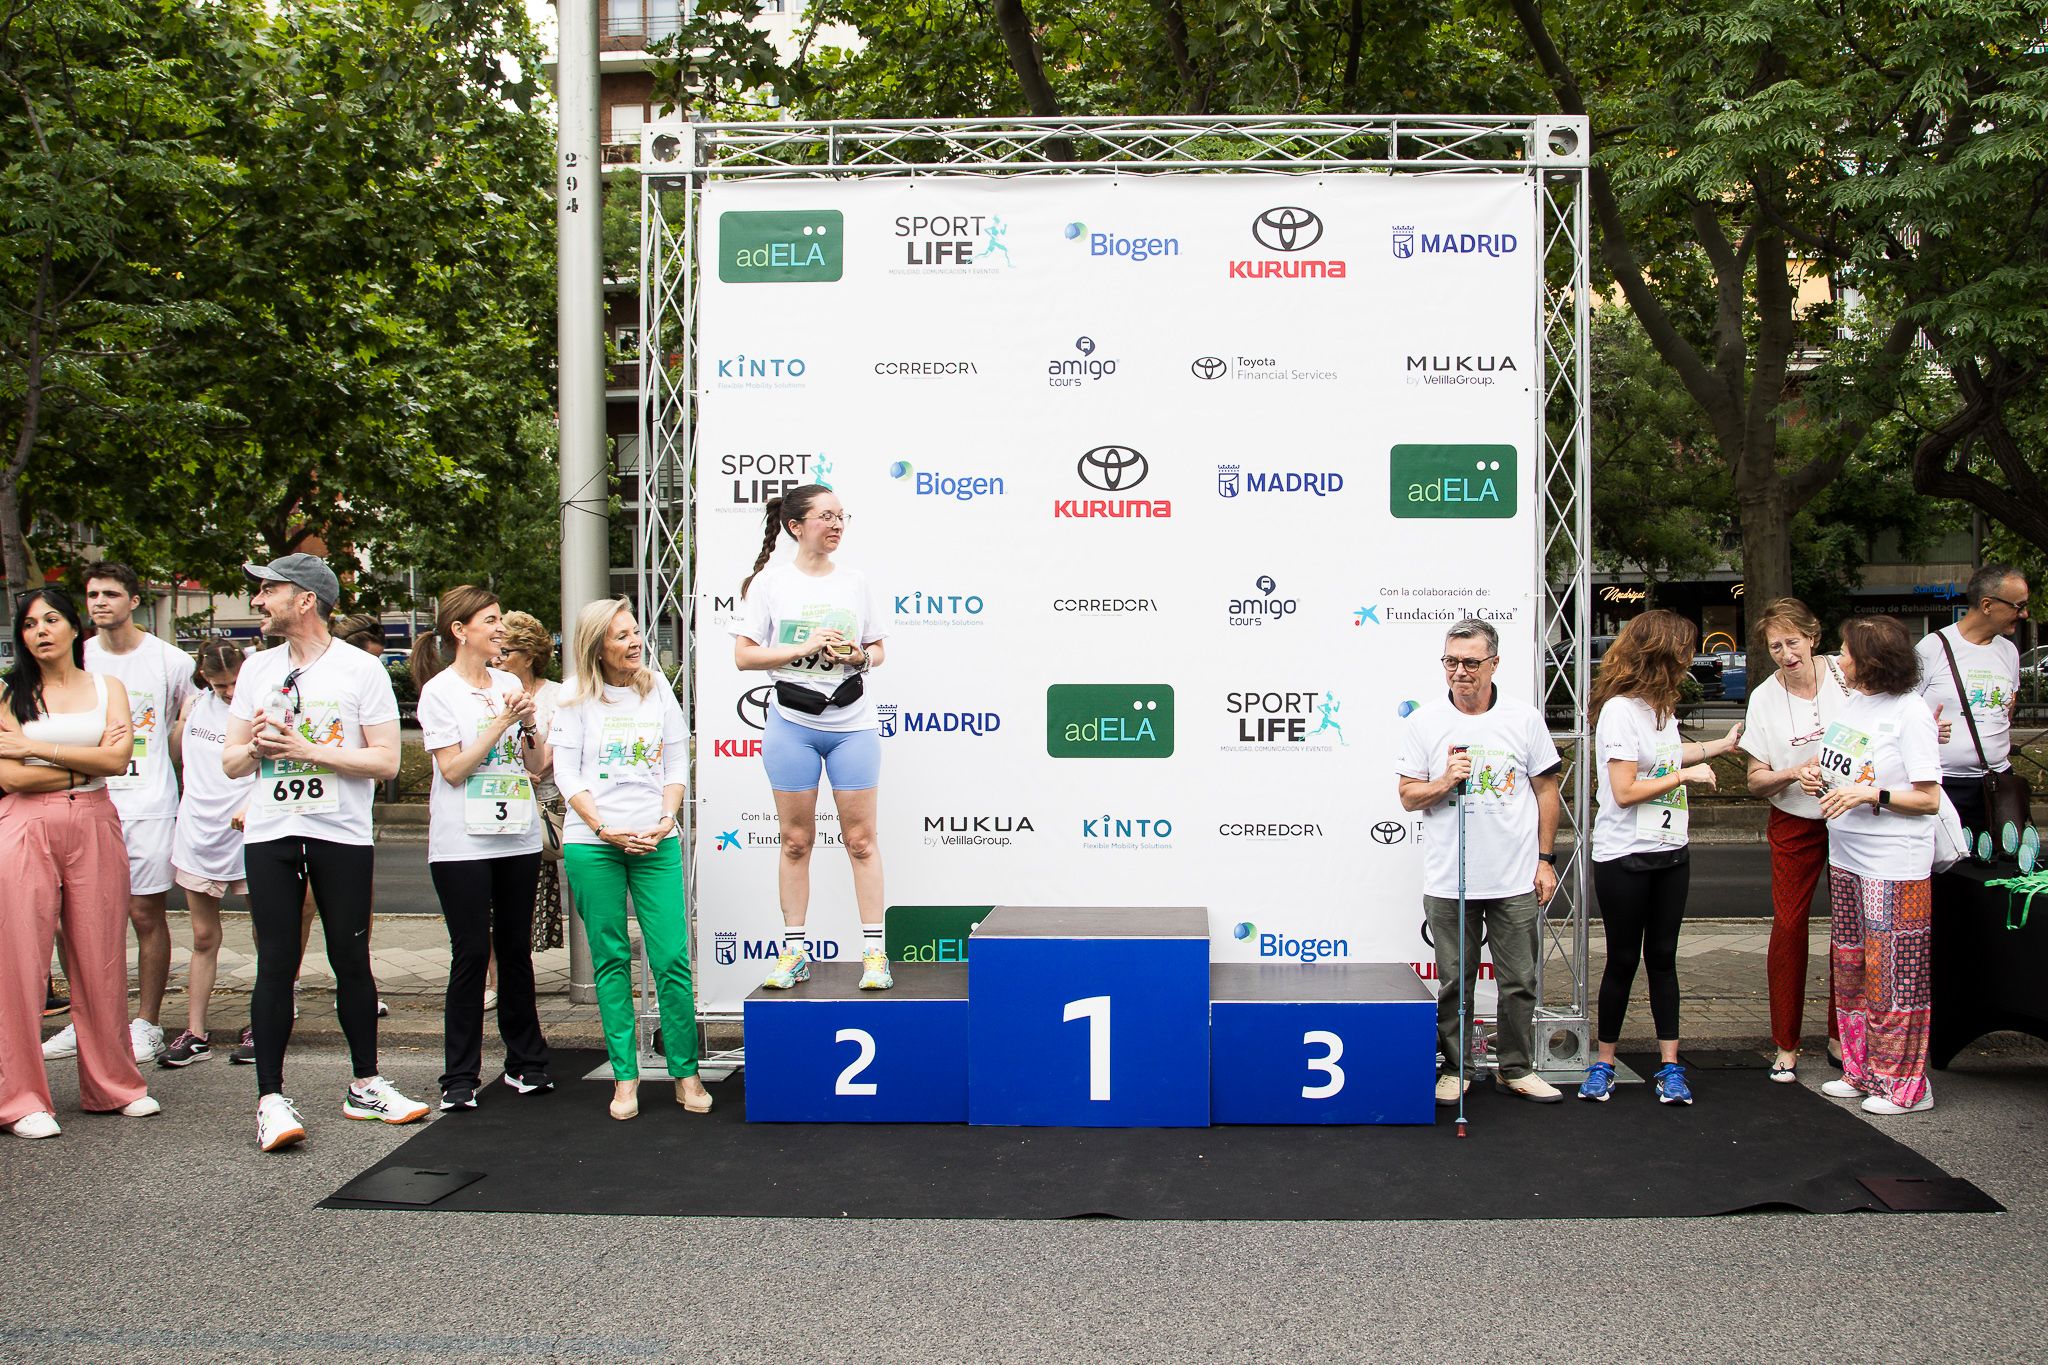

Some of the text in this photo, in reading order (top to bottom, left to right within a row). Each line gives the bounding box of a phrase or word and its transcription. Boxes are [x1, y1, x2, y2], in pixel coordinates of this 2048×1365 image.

[895, 216, 986, 237] SPORT
[736, 242, 826, 268] adELA
[907, 241, 973, 265] LIFE
[1090, 233, 1179, 262] Biogen
[1421, 233, 1518, 258] MADRID
[1048, 359, 1116, 381] amigo
[1237, 356, 1276, 369] Toyota
[1407, 356, 1517, 371] MUKUA
[1049, 376, 1082, 387] tours
[1237, 369, 1338, 380] Financial Services
[1406, 375, 1420, 387] by
[721, 454, 812, 475] SPORT
[916, 472, 1004, 501] Biogen
[1247, 472, 1344, 497] MADRID
[1407, 478, 1500, 502] adELA
[1379, 587, 1491, 597] Con la colaboración de:
[1913, 583, 1946, 594] Sanitas
[1228, 599, 1296, 620] amigo
[1386, 607, 1455, 621] Fundación
[1853, 602, 1953, 613] Centro de Rehabilitac
[923, 619, 949, 628] Mobility
[1229, 616, 1262, 627] tours
[1226, 692, 1319, 714] SPORT
[904, 712, 1001, 737] MADRID
[1064, 717, 1157, 742] adELA
[1239, 718, 1306, 742] LIFE
[714, 739, 762, 757] KUR
[1820, 747, 1852, 776] 1198
[273, 778, 324, 802] 698
[495, 801, 508, 821] 3
[741, 812, 760, 821] Con
[763, 812, 771, 821] la
[1661, 810, 1672, 829] 2
[924, 816, 1035, 832] MUKUA
[924, 835, 1012, 848] by VelillaGroup.
[1111, 842, 1139, 851] Mobility
[743, 940, 839, 963] MARID
[903, 938, 968, 962] adEL
[1259, 933, 1348, 962] Biogen
[1062, 994, 1111, 1102] 1
[834, 1028, 878, 1096] 2
[1300, 1029, 1346, 1100] 3
